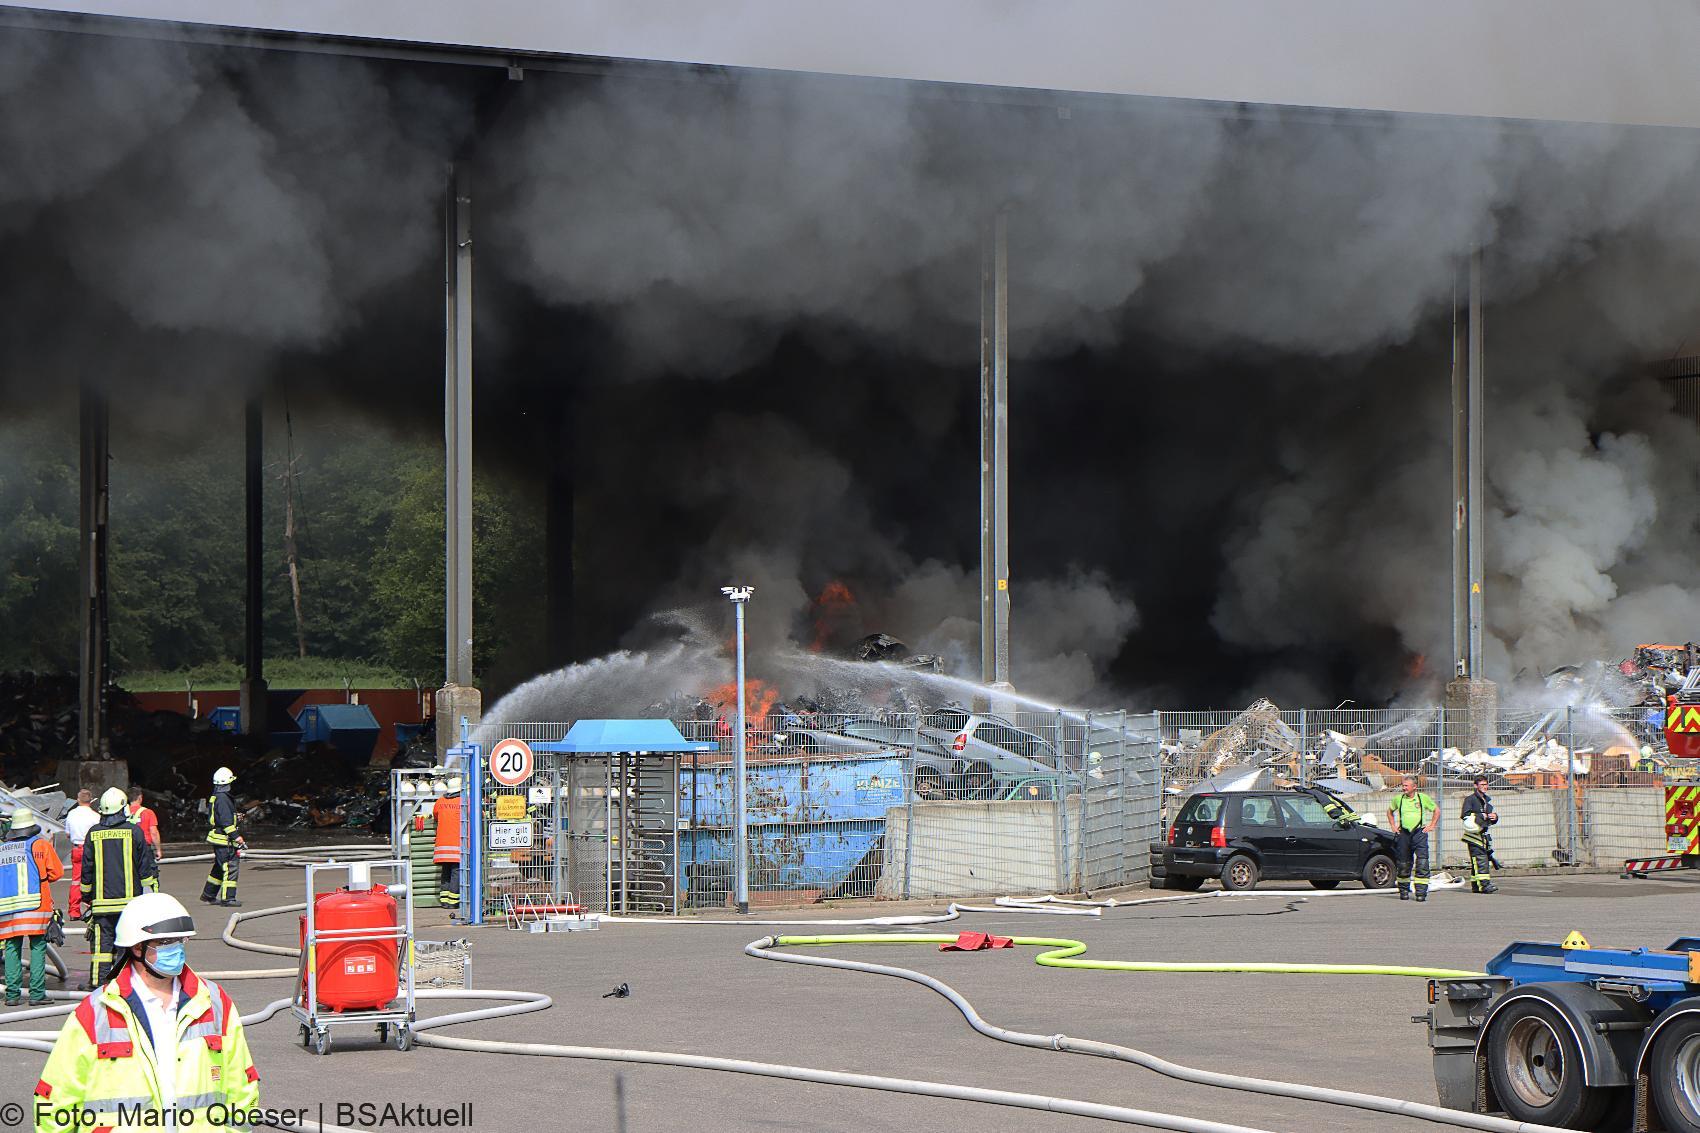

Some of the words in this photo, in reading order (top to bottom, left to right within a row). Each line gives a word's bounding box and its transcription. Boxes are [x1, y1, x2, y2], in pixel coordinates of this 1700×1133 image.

[998, 579, 1007, 590] B
[1472, 582, 1480, 593] A
[500, 752, 523, 772] 20
[1664, 767, 1697, 777] KUNZE
[92, 831, 131, 840] FEUERWEHR
[495, 826, 511, 834] Hier
[516, 826, 528, 835] gilt
[495, 836, 506, 844] die
[511, 836, 528, 844] StVO
